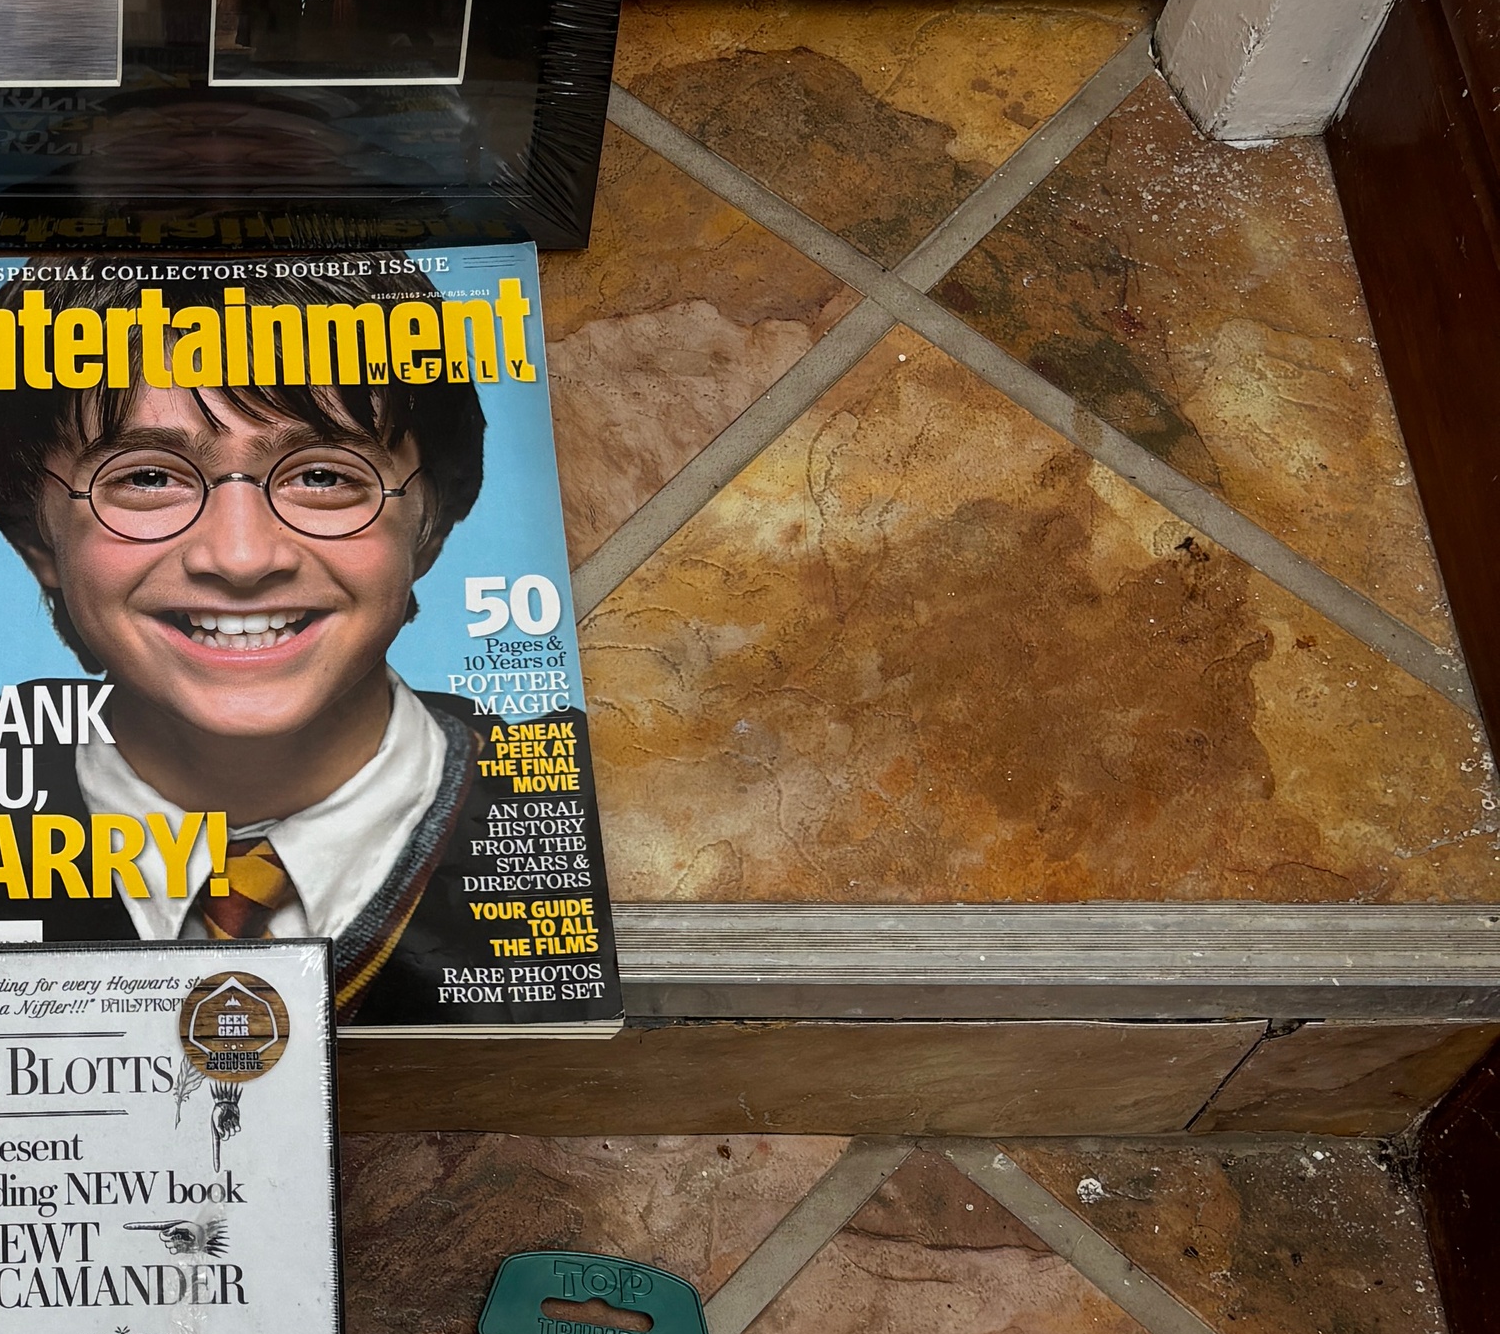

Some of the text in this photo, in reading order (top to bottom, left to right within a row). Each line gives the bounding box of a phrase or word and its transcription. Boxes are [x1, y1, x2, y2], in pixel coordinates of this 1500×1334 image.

[101, 263, 268, 281] COLLECTOR'S
[275, 260, 371, 279] DOUBLE
[379, 257, 449, 276] ISSUE
[368, 359, 527, 384] WEEKLY
[465, 574, 561, 638] 50
[486, 636, 563, 656] Pages &
[464, 652, 566, 671] 10 Years of
[448, 671, 569, 694] POTTER
[473, 692, 571, 715] MAGIC
[490, 722, 575, 742] A SNEAK
[496, 740, 577, 759] PEEK AT
[477, 757, 580, 777] THE FINAL
[513, 774, 580, 793] MOVIE
[6, 1047, 174, 1097] BLOTTS
[64, 1171, 155, 1205] NEW
[167, 1170, 246, 1204] book
[553, 1260, 654, 1303] TOP
